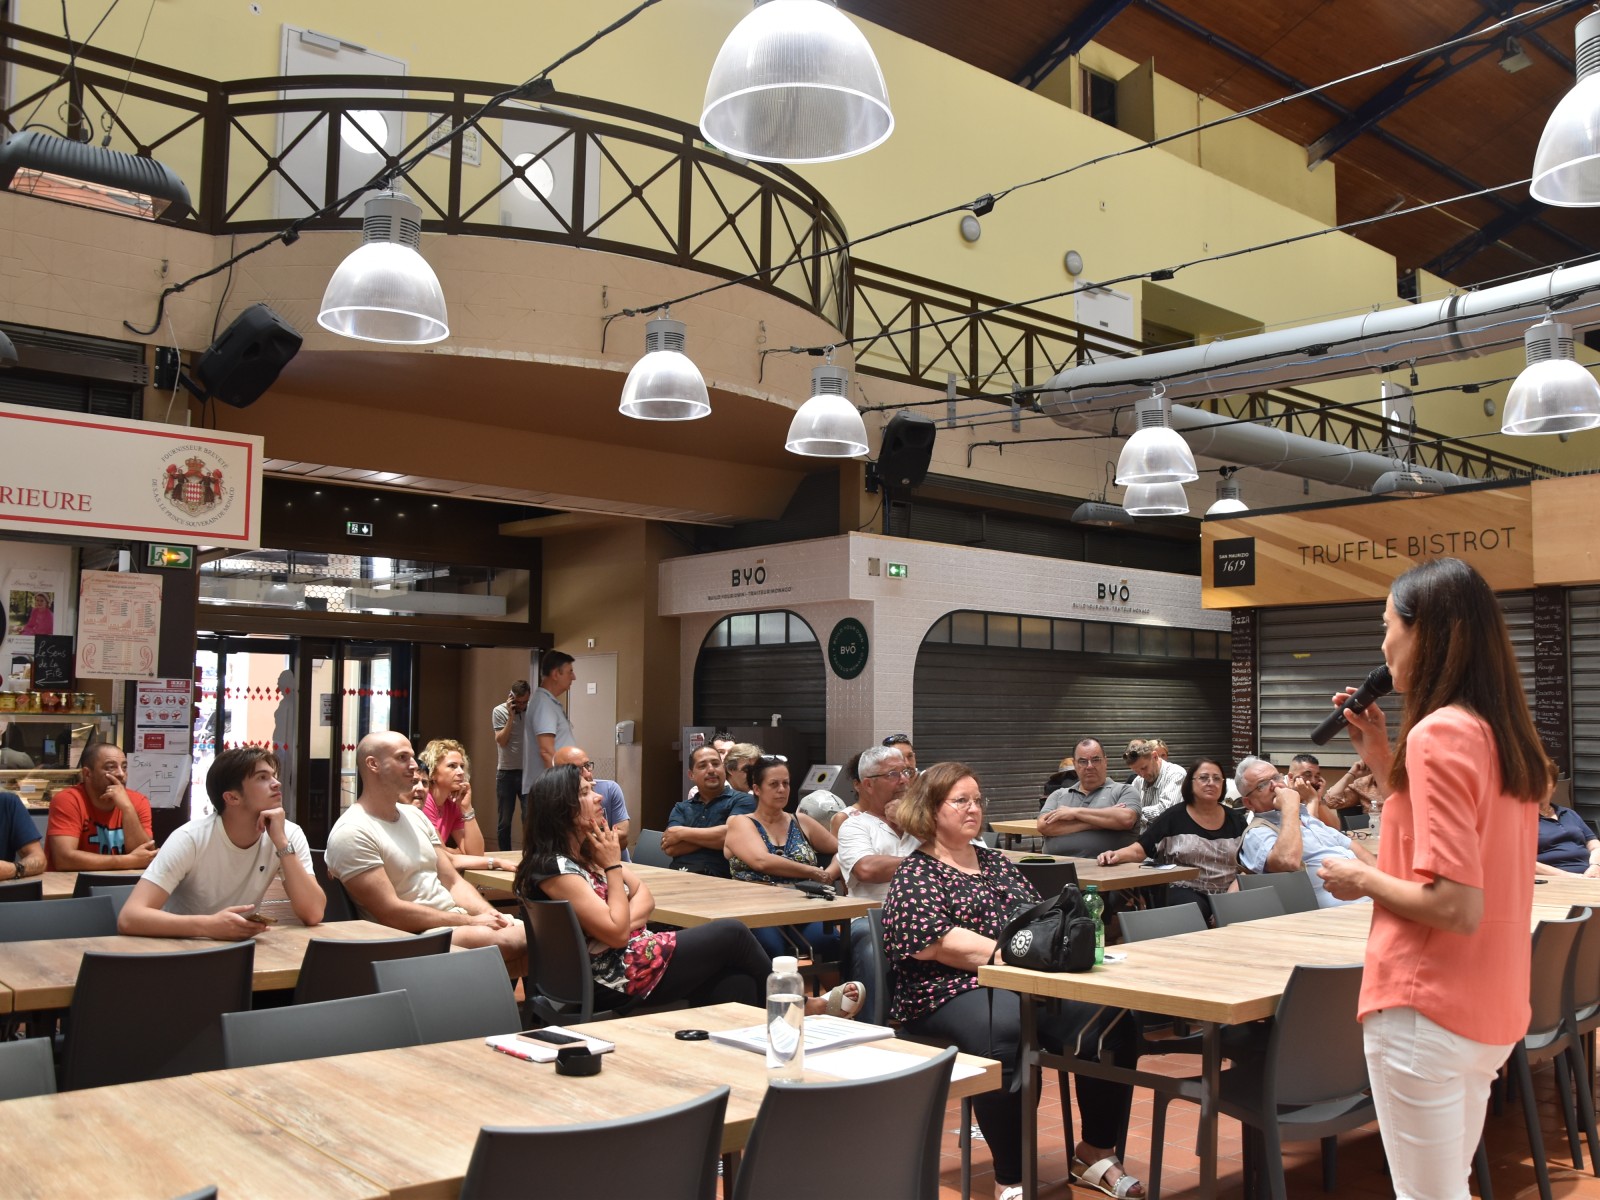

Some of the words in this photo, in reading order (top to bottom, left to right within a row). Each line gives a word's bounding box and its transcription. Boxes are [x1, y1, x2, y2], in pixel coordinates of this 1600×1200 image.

[161, 445, 202, 462] FOURNISSEUR
[0, 486, 92, 512] RIEURE
[165, 510, 184, 525] PRINCE
[185, 515, 218, 527] SOUVERAIN
[223, 486, 235, 514] MONACO
[1298, 538, 1397, 565] TRUFFLE
[1408, 527, 1516, 556] BISTROT
[1223, 560, 1246, 572] 1619
